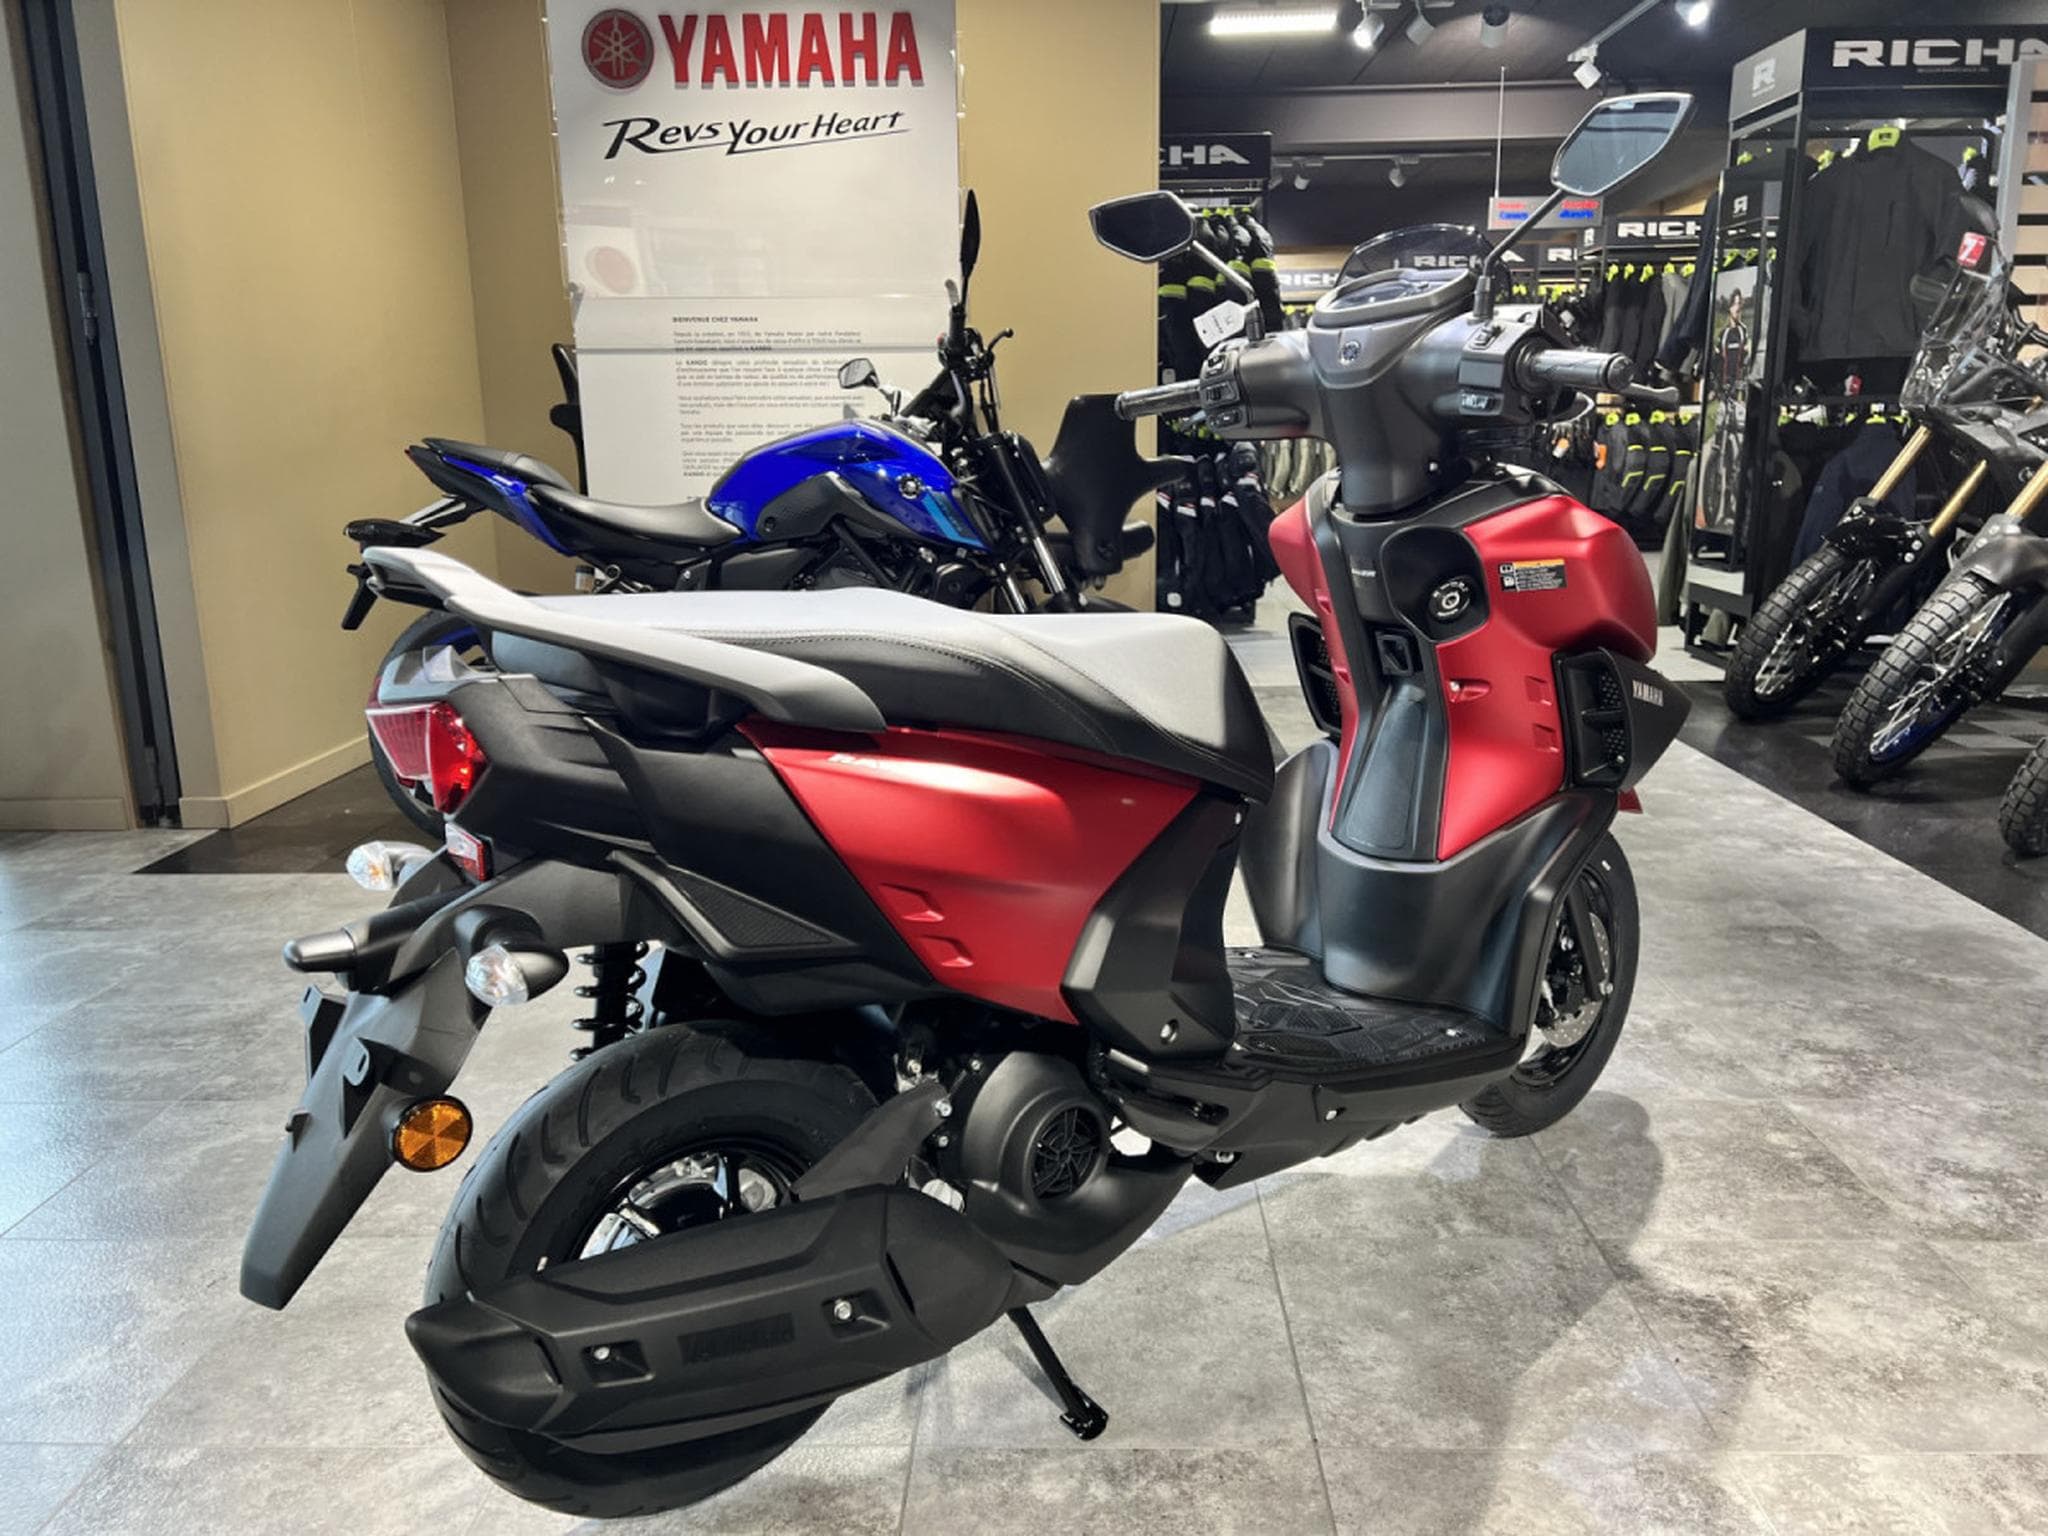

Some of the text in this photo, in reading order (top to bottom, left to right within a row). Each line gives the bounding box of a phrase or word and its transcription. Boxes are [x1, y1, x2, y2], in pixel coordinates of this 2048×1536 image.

[657, 11, 924, 89] YAMAHA
[602, 110, 906, 160] Revs Your Heart
